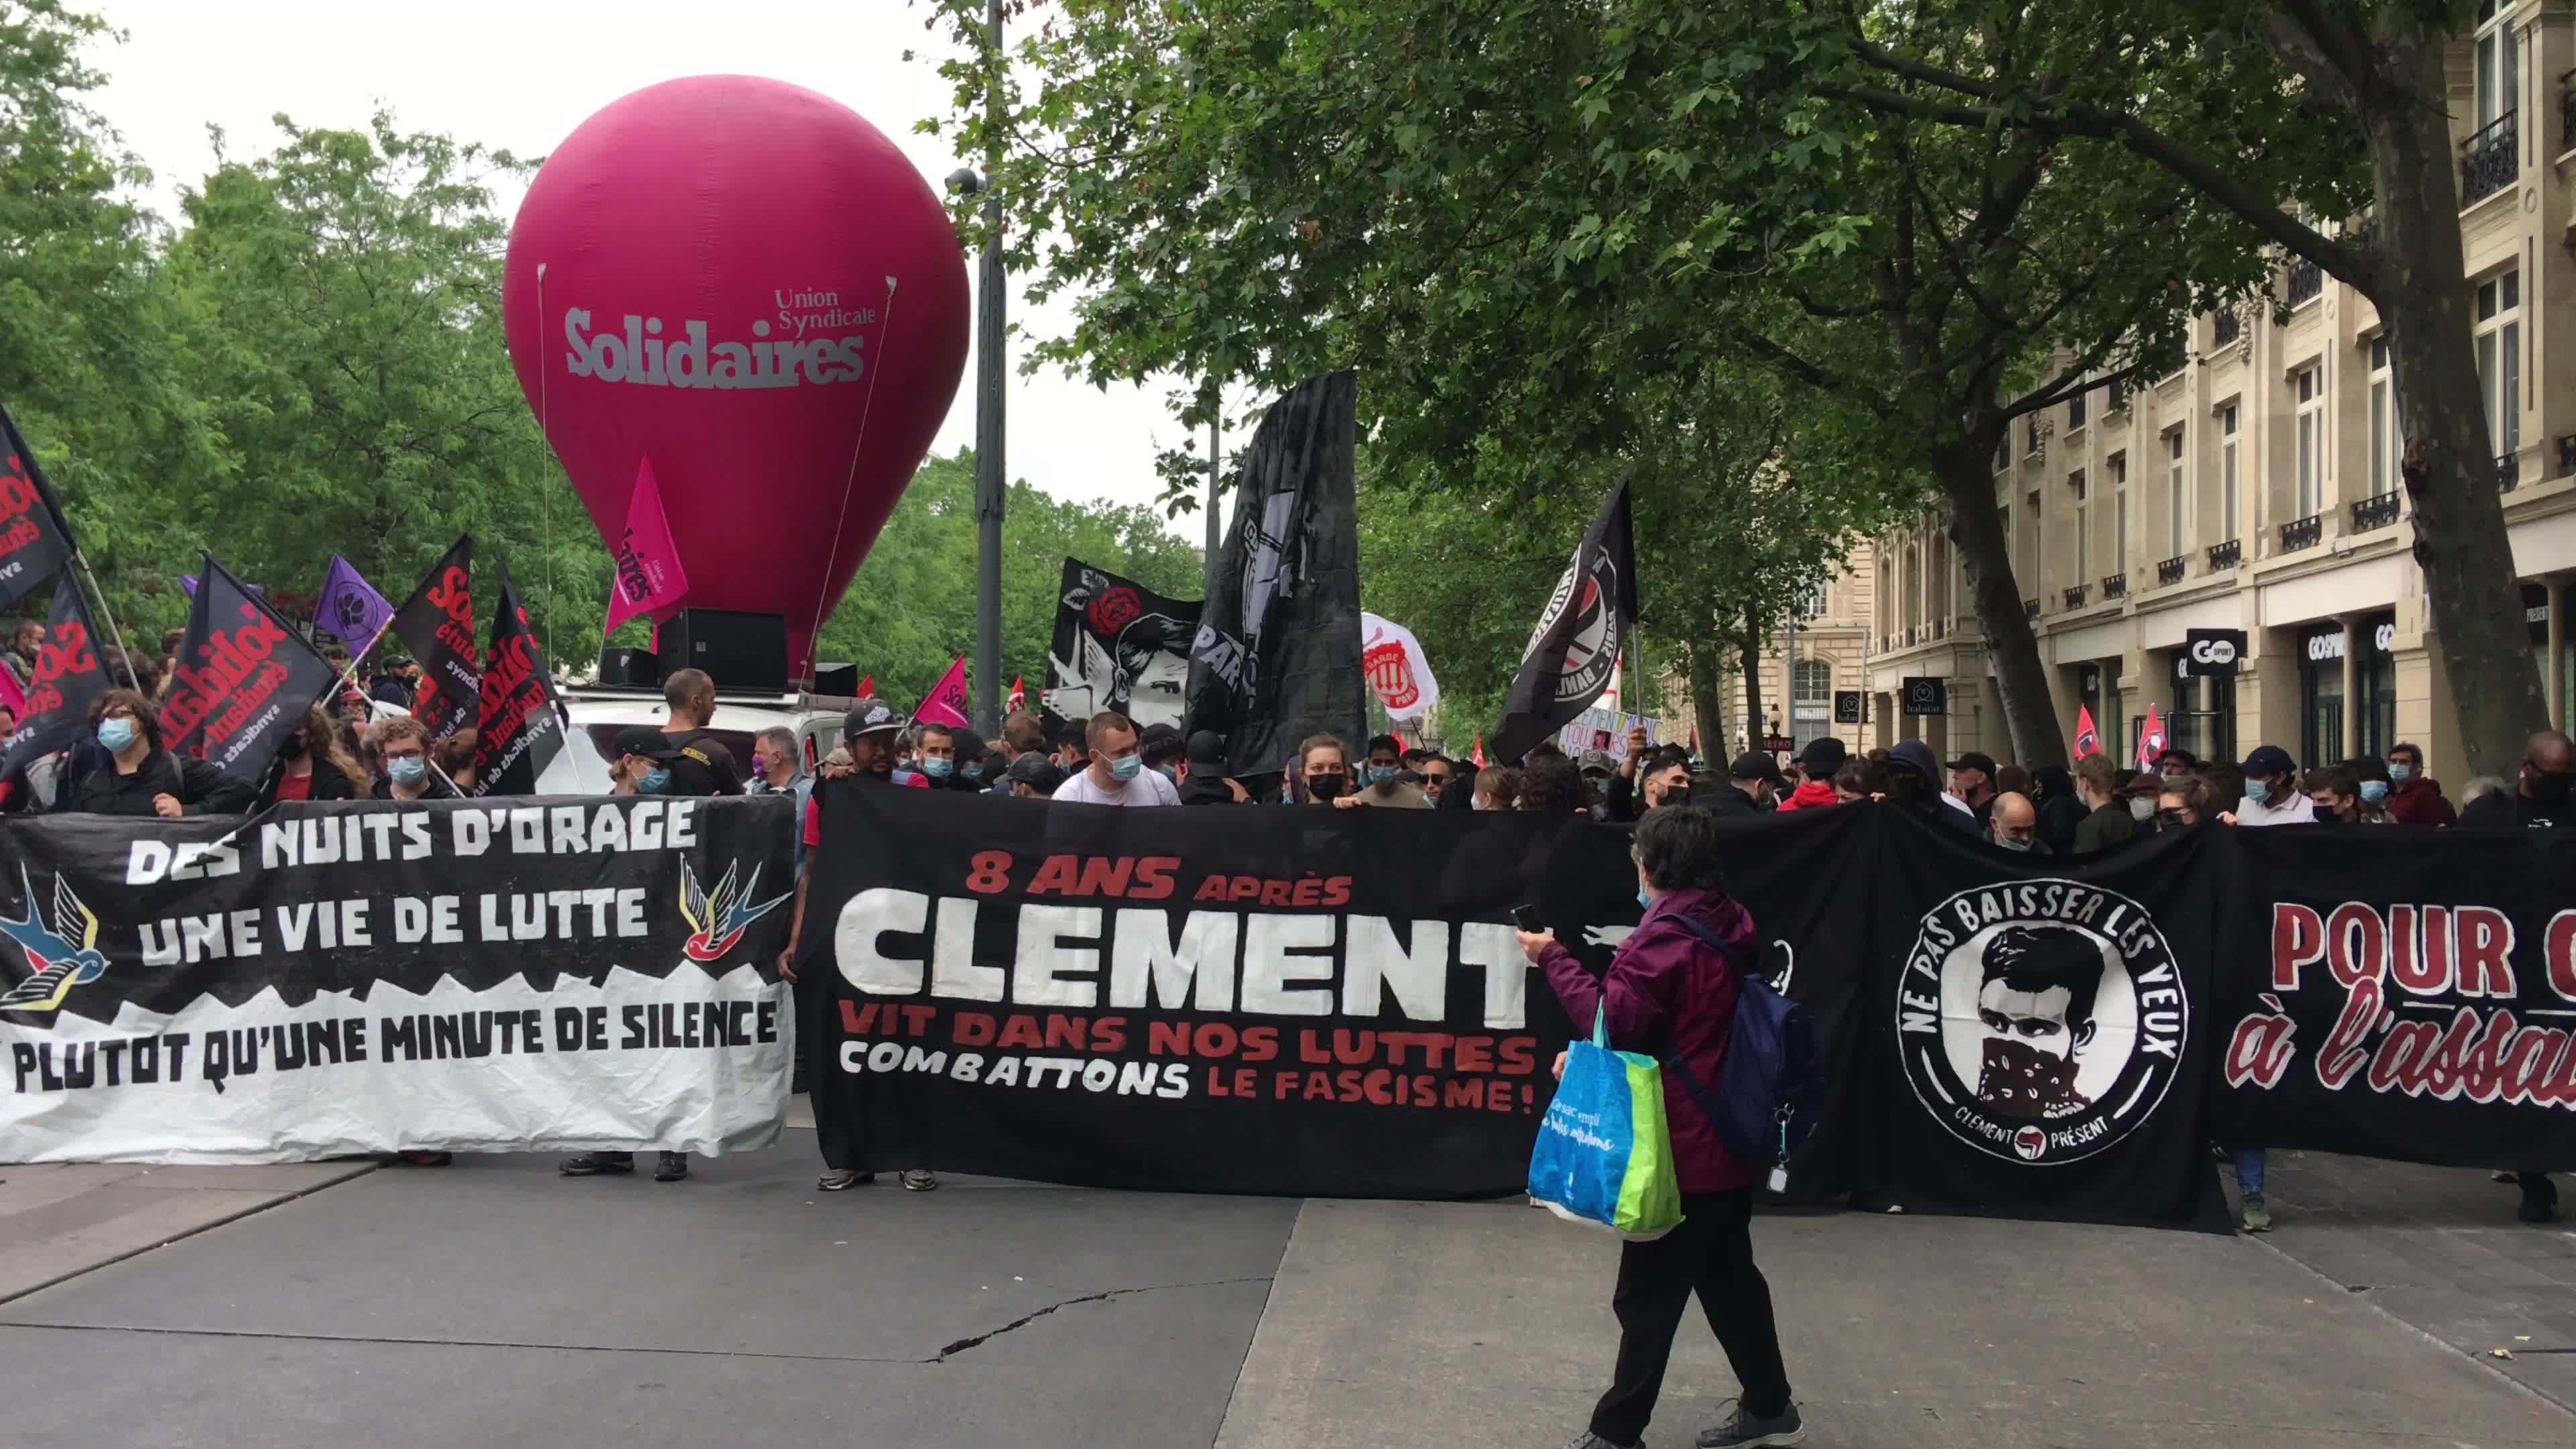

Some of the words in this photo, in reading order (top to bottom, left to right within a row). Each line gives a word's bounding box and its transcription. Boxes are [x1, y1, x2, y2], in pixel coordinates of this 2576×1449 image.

[774, 287, 838, 309] Union
[778, 307, 875, 337] Syndicale
[564, 307, 865, 389] Solidaires
[2192, 640, 2236, 663] GO
[125, 831, 242, 885] DES
[262, 810, 431, 870] NUITS
[452, 800, 696, 857] D'ORAGE
[965, 850, 1014, 894] 8
[1026, 854, 1181, 900] ANS
[1194, 870, 1352, 906] APRÈS
[1954, 884, 2104, 932] BAISSER
[139, 907, 262, 967] UNE
[277, 898, 373, 953] VIE
[394, 894, 461, 945] DE
[480, 888, 649, 941] LUTTE
[833, 887, 1553, 1030] CLEMENT
[1913, 916, 1955, 981] PAS
[2102, 904, 2156, 959] LES
[2271, 900, 2517, 1000] POUR
[837, 999, 938, 1037] VIT
[952, 1011, 1128, 1053] DANS
[1148, 1020, 1279, 1062] NOS
[1299, 1030, 1536, 1075] LUTTES
[1901, 990, 1938, 1034] NE
[2138, 961, 2180, 1059] YEUX
[13, 1032, 191, 1093] PLUTOT
[203, 1016, 367, 1095] QU'UNE
[381, 1008, 544, 1063] MINUTE
[554, 1006, 608, 1052] DE
[621, 1000, 778, 1049] SILENCE
[838, 1040, 1189, 1099] COMBATTONS
[1208, 1067, 1257, 1099] LE
[2224, 991, 2300, 1089] à
[2316, 975, 2576, 1112] l'assa
[1954, 1106, 2014, 1144] CLÉMENT
[2051, 1116, 2108, 1149] PRÉSENT
